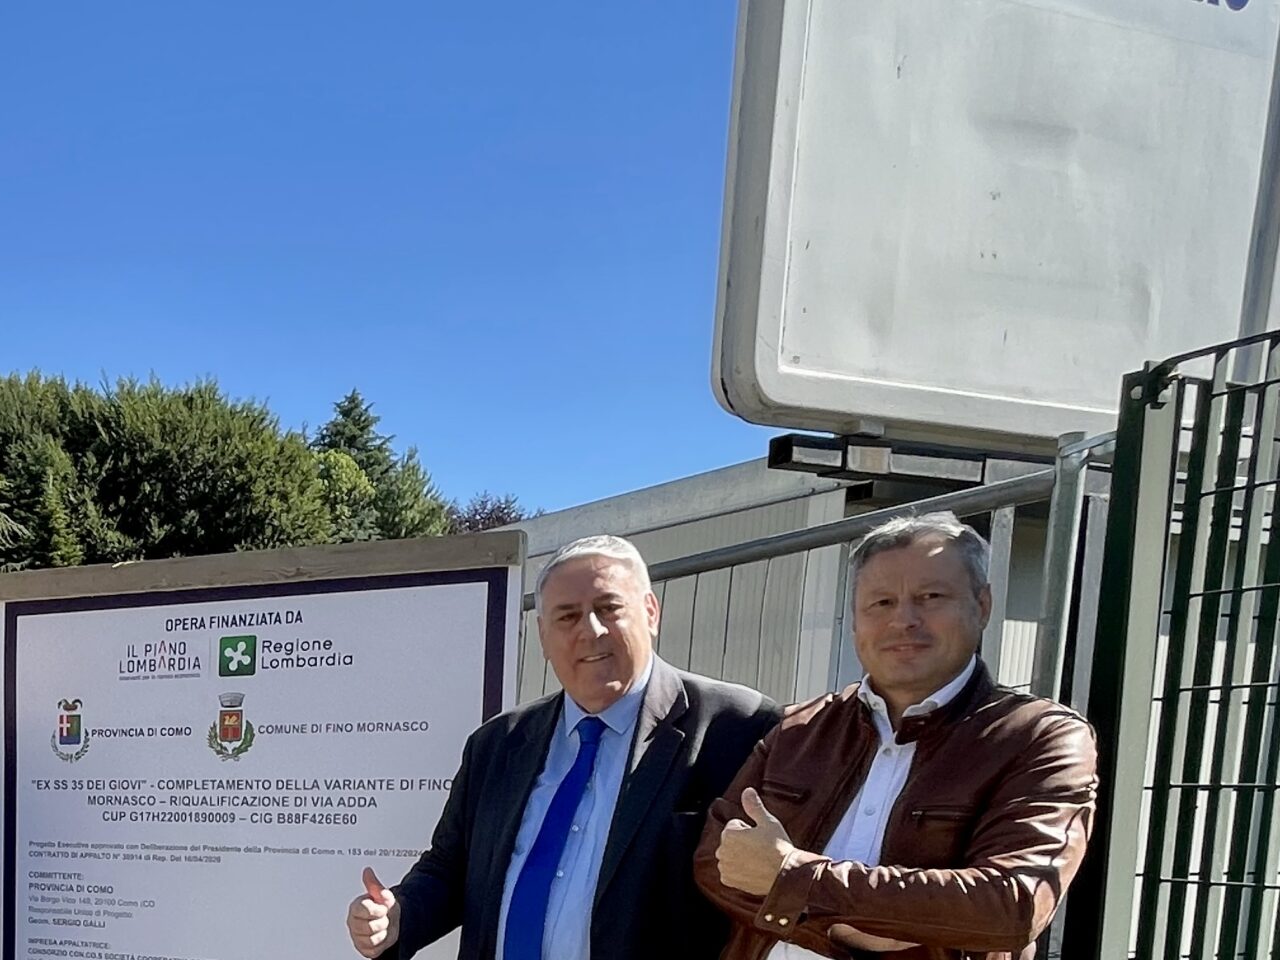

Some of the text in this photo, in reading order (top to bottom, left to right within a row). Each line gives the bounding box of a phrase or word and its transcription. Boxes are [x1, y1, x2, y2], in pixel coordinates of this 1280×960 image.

[165, 611, 303, 632] OPERA FINANZIATA DA
[127, 640, 186, 658] IL PIANO
[261, 638, 333, 656] Regione
[119, 656, 201, 673] LOMBARDIA
[261, 650, 354, 670] Lombardia
[91, 727, 192, 738] PROVINCIA DI COMO
[258, 721, 429, 735] COMUNE DI FINO MORNASCO
[53, 780, 68, 791] SS
[71, 780, 84, 791] 35
[87, 780, 106, 790] DEI
[108, 779, 147, 791] GIOVI"
[157, 779, 271, 791] COMPLETAMENTO
[276, 779, 320, 791] DELLA
[324, 779, 394, 791] VARIANTE
[400, 779, 414, 791] DI
[87, 796, 156, 807] MORNASCO
[170, 796, 290, 808] RIQUALIFICAZIONE
[294, 797, 307, 808] DI
[311, 797, 333, 808] VIA
[337, 797, 378, 808] ADDA
[102, 811, 126, 822] CUP
[129, 811, 236, 823] G17H22001890009
[250, 812, 273, 824] CIG
[277, 813, 357, 825] B88F426E60
[28, 883, 114, 894] PROVINCIA DI COMO
